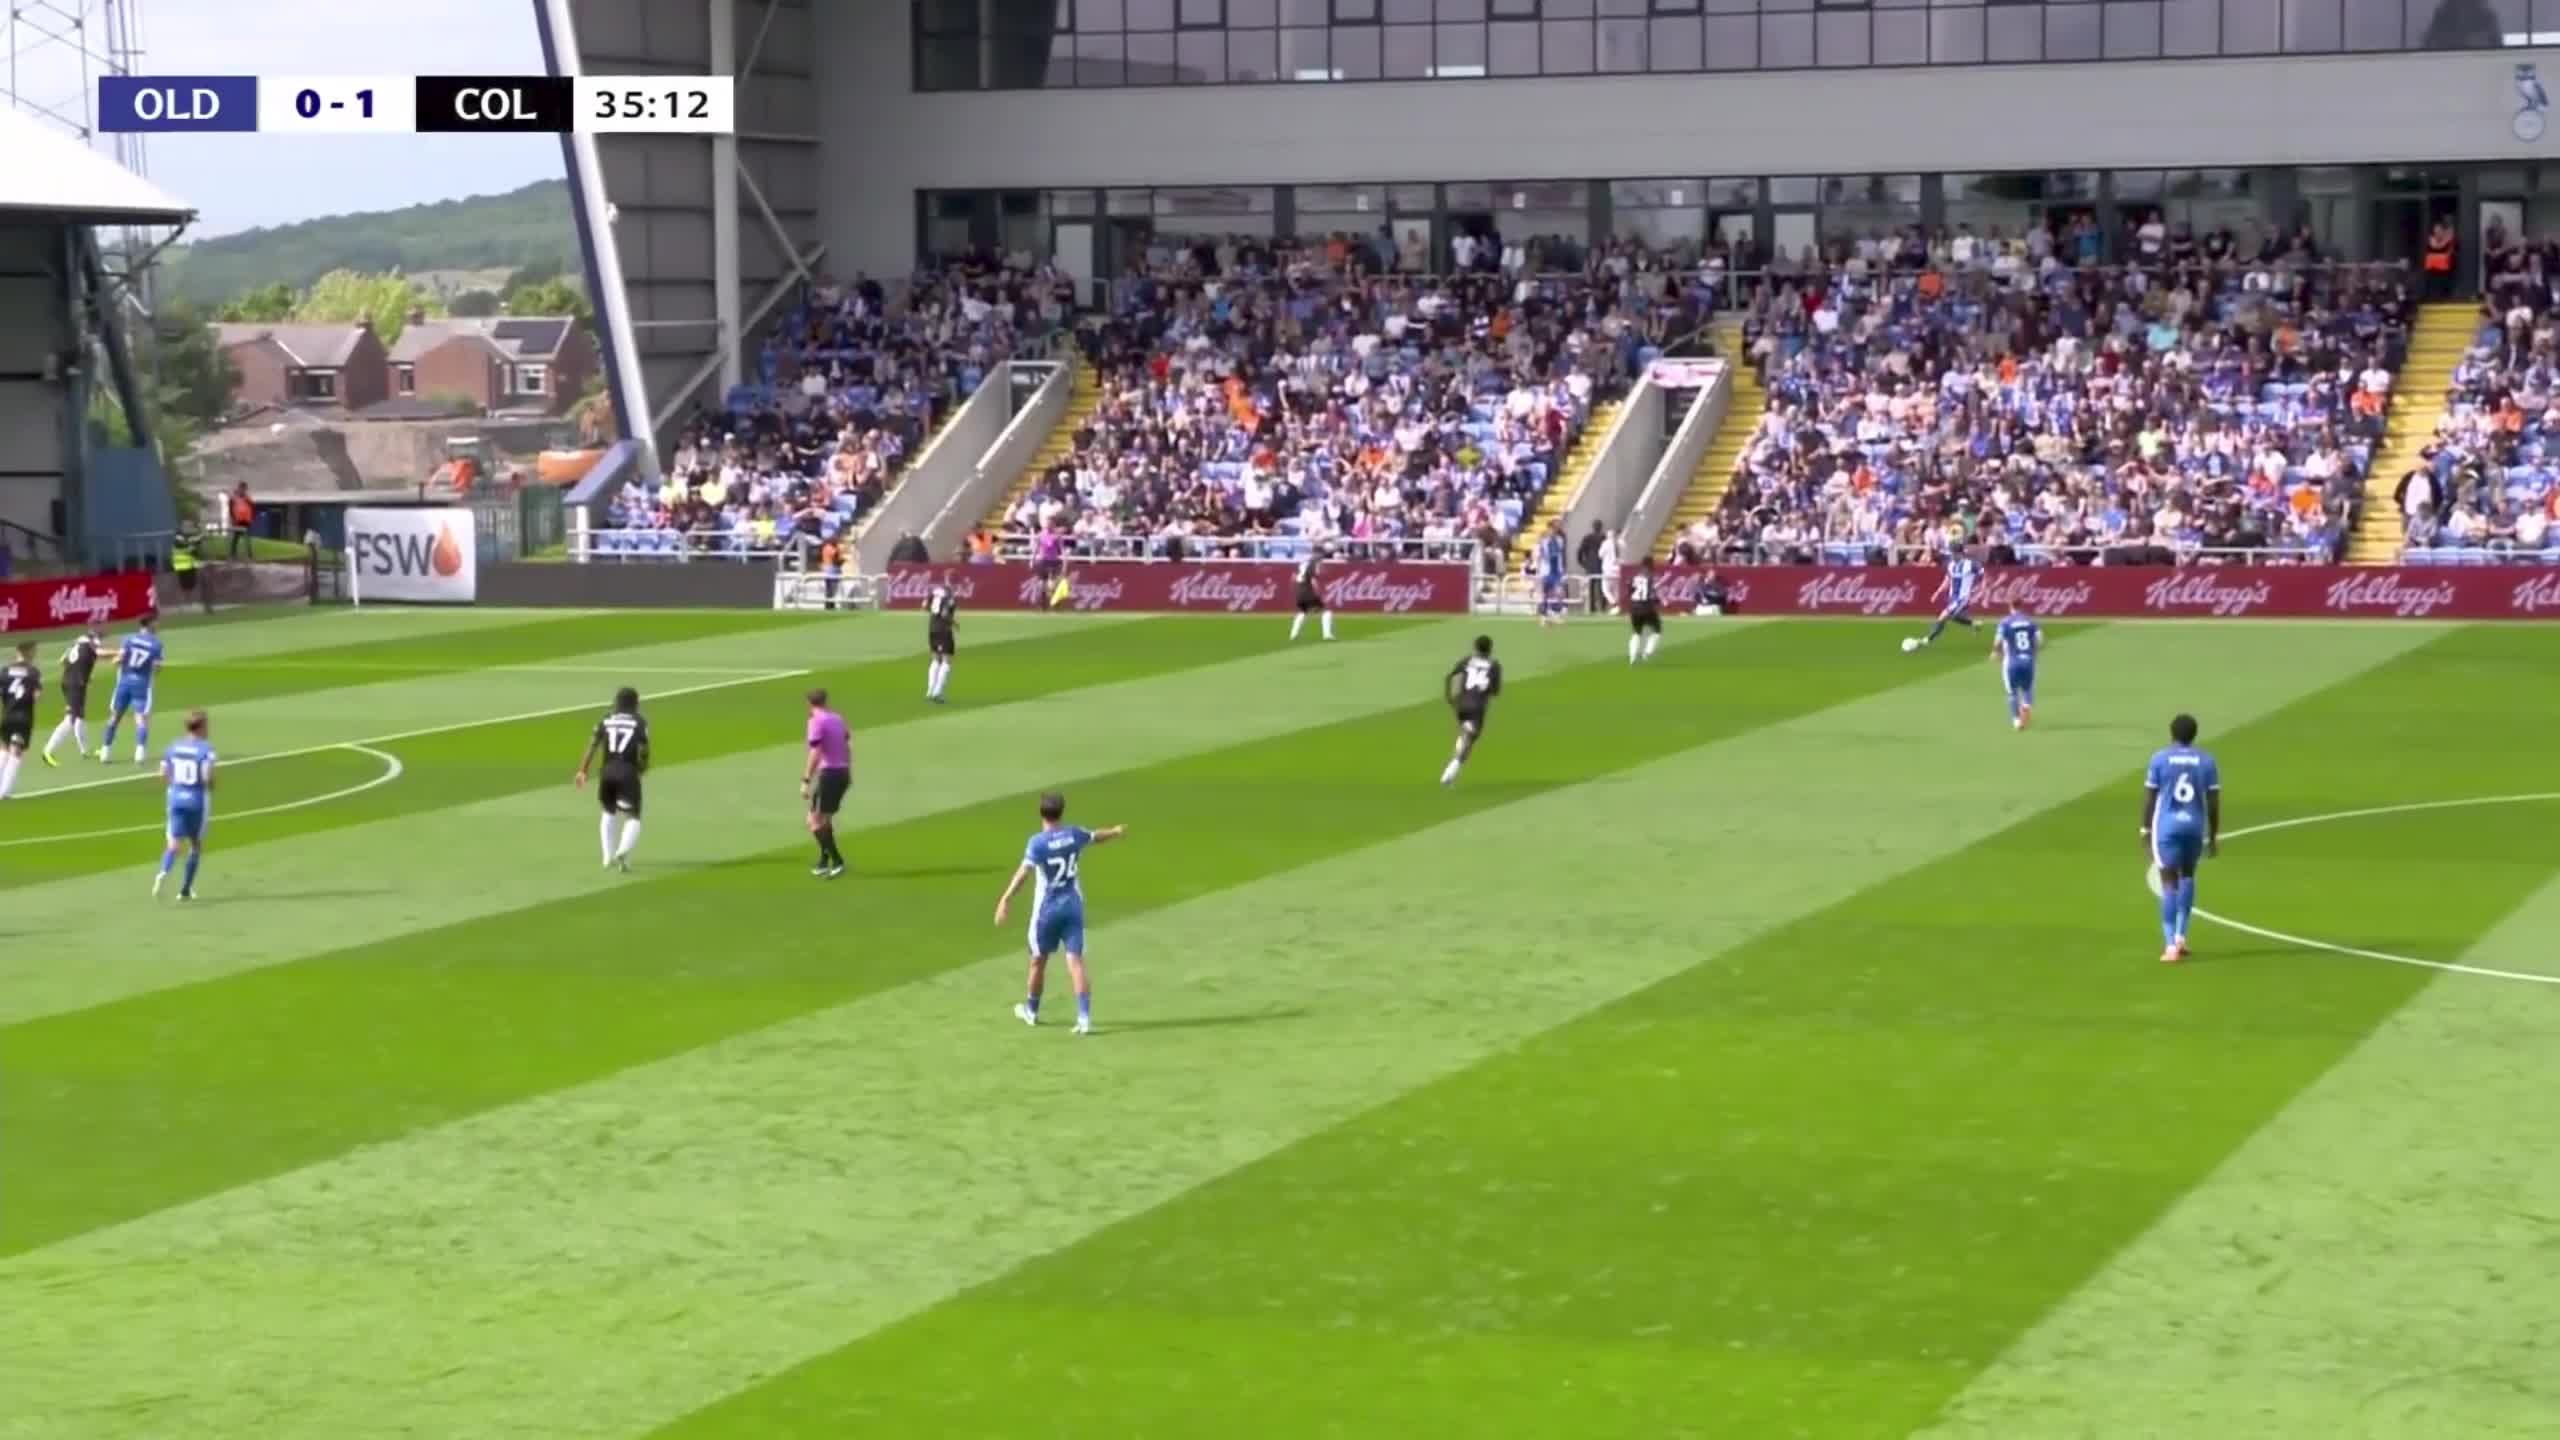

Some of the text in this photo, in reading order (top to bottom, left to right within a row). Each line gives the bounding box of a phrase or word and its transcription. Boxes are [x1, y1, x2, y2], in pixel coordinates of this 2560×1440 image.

[354, 532, 435, 577] FSW
[49, 583, 118, 622] Kellogg's
[1169, 570, 1277, 610] Kellogg's
[1323, 571, 1435, 612] Kellogg's
[1798, 571, 1917, 614] Kellogg's
[2145, 571, 2272, 616] Kellogg's
[2326, 571, 2456, 617] Kellogg's
[129, 647, 150, 668] 17
[2015, 630, 2030, 650] 8
[605, 727, 635, 753] 17
[172, 757, 198, 785] 10
[2174, 772, 2195, 803] 6
